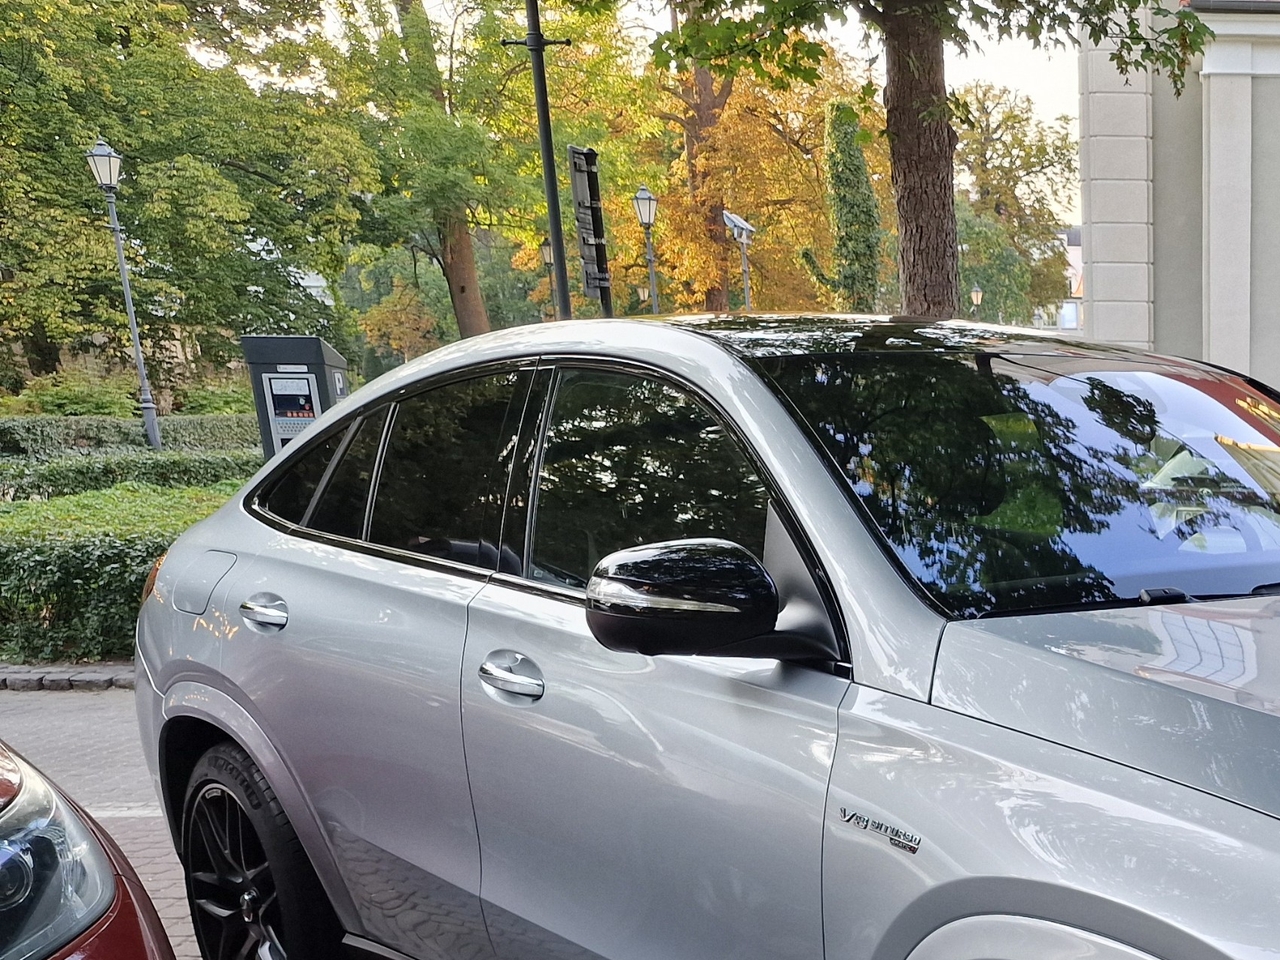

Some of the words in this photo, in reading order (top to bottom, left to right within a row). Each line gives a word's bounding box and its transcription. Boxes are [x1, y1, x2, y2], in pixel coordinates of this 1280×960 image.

[333, 372, 344, 396] P
[839, 807, 870, 830] V8
[870, 820, 922, 846] BITURBO
